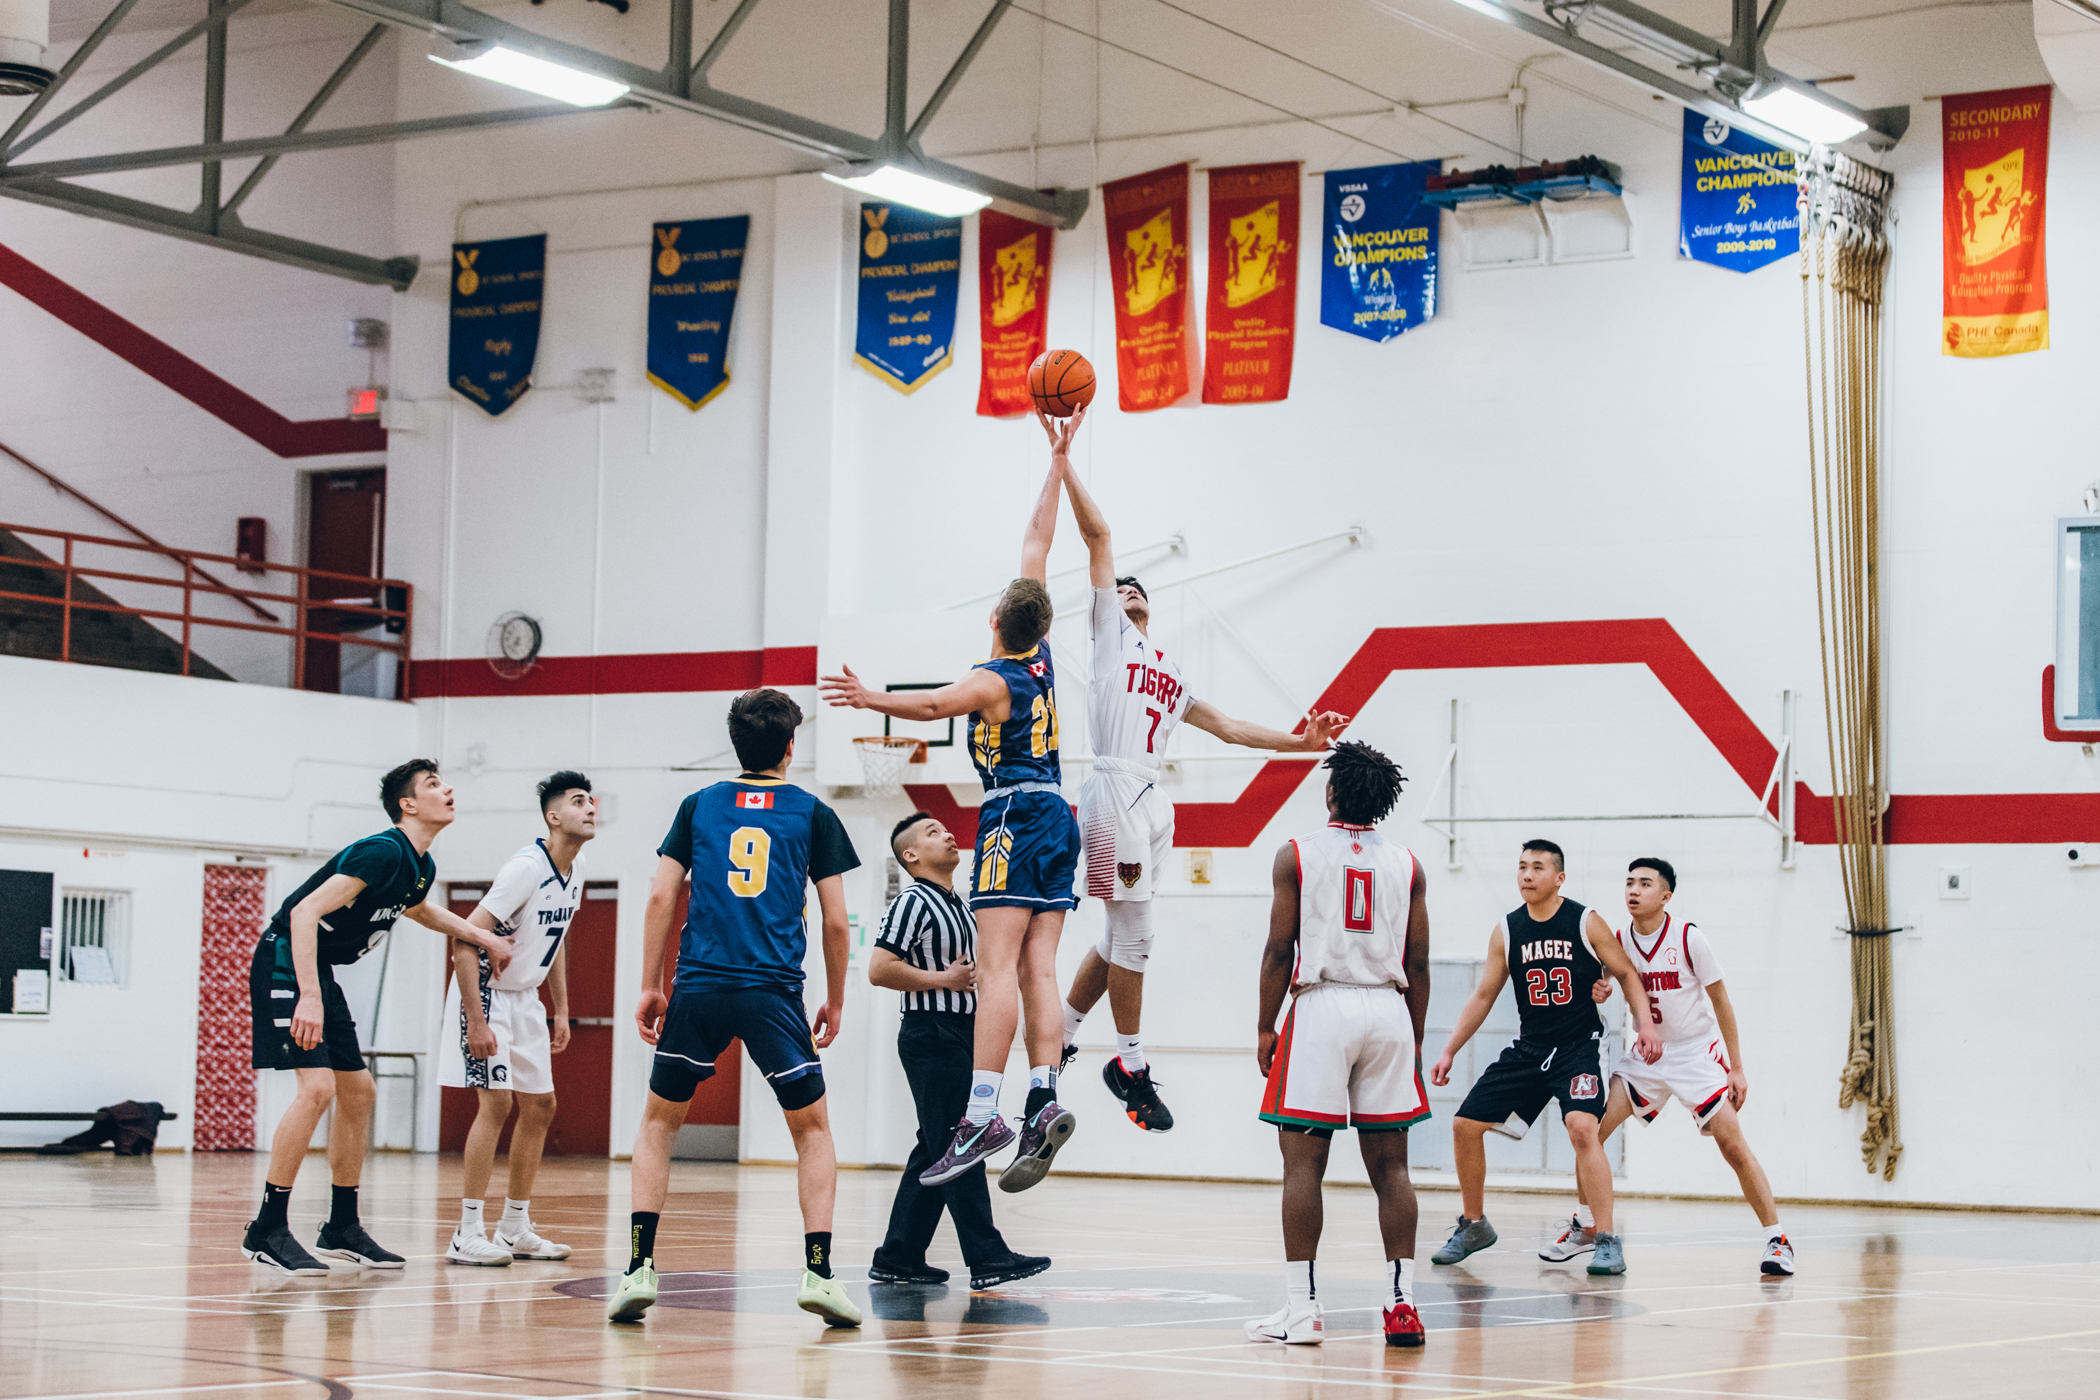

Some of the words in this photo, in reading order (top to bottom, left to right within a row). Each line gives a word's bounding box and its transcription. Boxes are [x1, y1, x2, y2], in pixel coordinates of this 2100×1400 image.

[1950, 103, 2041, 127] SECONDARY
[1949, 126, 2000, 141] 2010-11
[1333, 227, 1429, 248] VANCOUVER
[1691, 224, 1723, 238] Senior
[1724, 221, 1747, 238] Boys
[1334, 245, 1429, 267] CHAMPIONS
[1716, 238, 1776, 254] 2009-2010
[1959, 271, 1988, 285] Quality
[1990, 268, 2026, 283] Physical
[1951, 284, 1994, 298] Education
[1995, 282, 2033, 296] Program
[1994, 323, 2040, 337] Canada
[1223, 359, 1270, 376] PLATINUM
[1127, 663, 1183, 714] TIGERS
[1146, 706, 1161, 754] 7
[727, 826, 771, 898] 9
[1343, 865, 1375, 934] 0
[539, 927, 564, 967] 7
[1521, 940, 1573, 964] MAGEE
[1526, 966, 1573, 1007] 23
